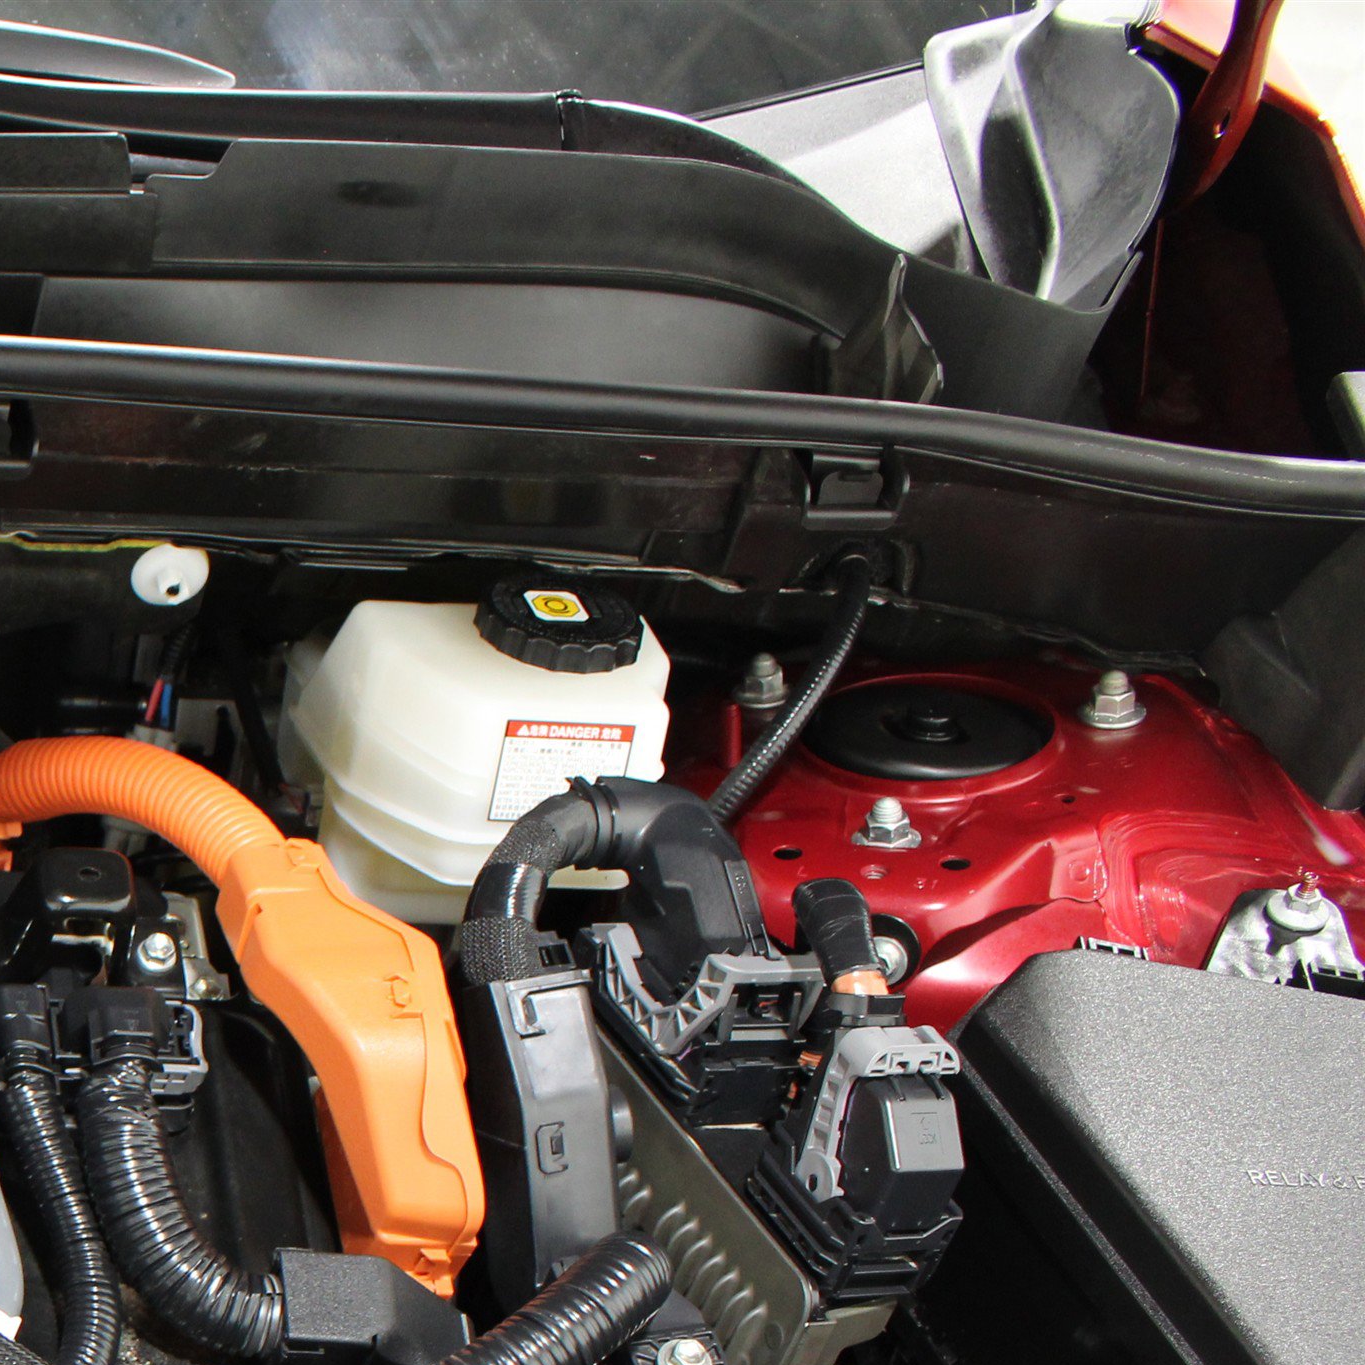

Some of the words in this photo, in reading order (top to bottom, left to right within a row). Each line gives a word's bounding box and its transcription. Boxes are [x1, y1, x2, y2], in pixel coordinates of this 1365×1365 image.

[550, 726, 599, 739] DANGER
[1246, 1169, 1325, 1187] RELAY
[1333, 1176, 1350, 1189] &
